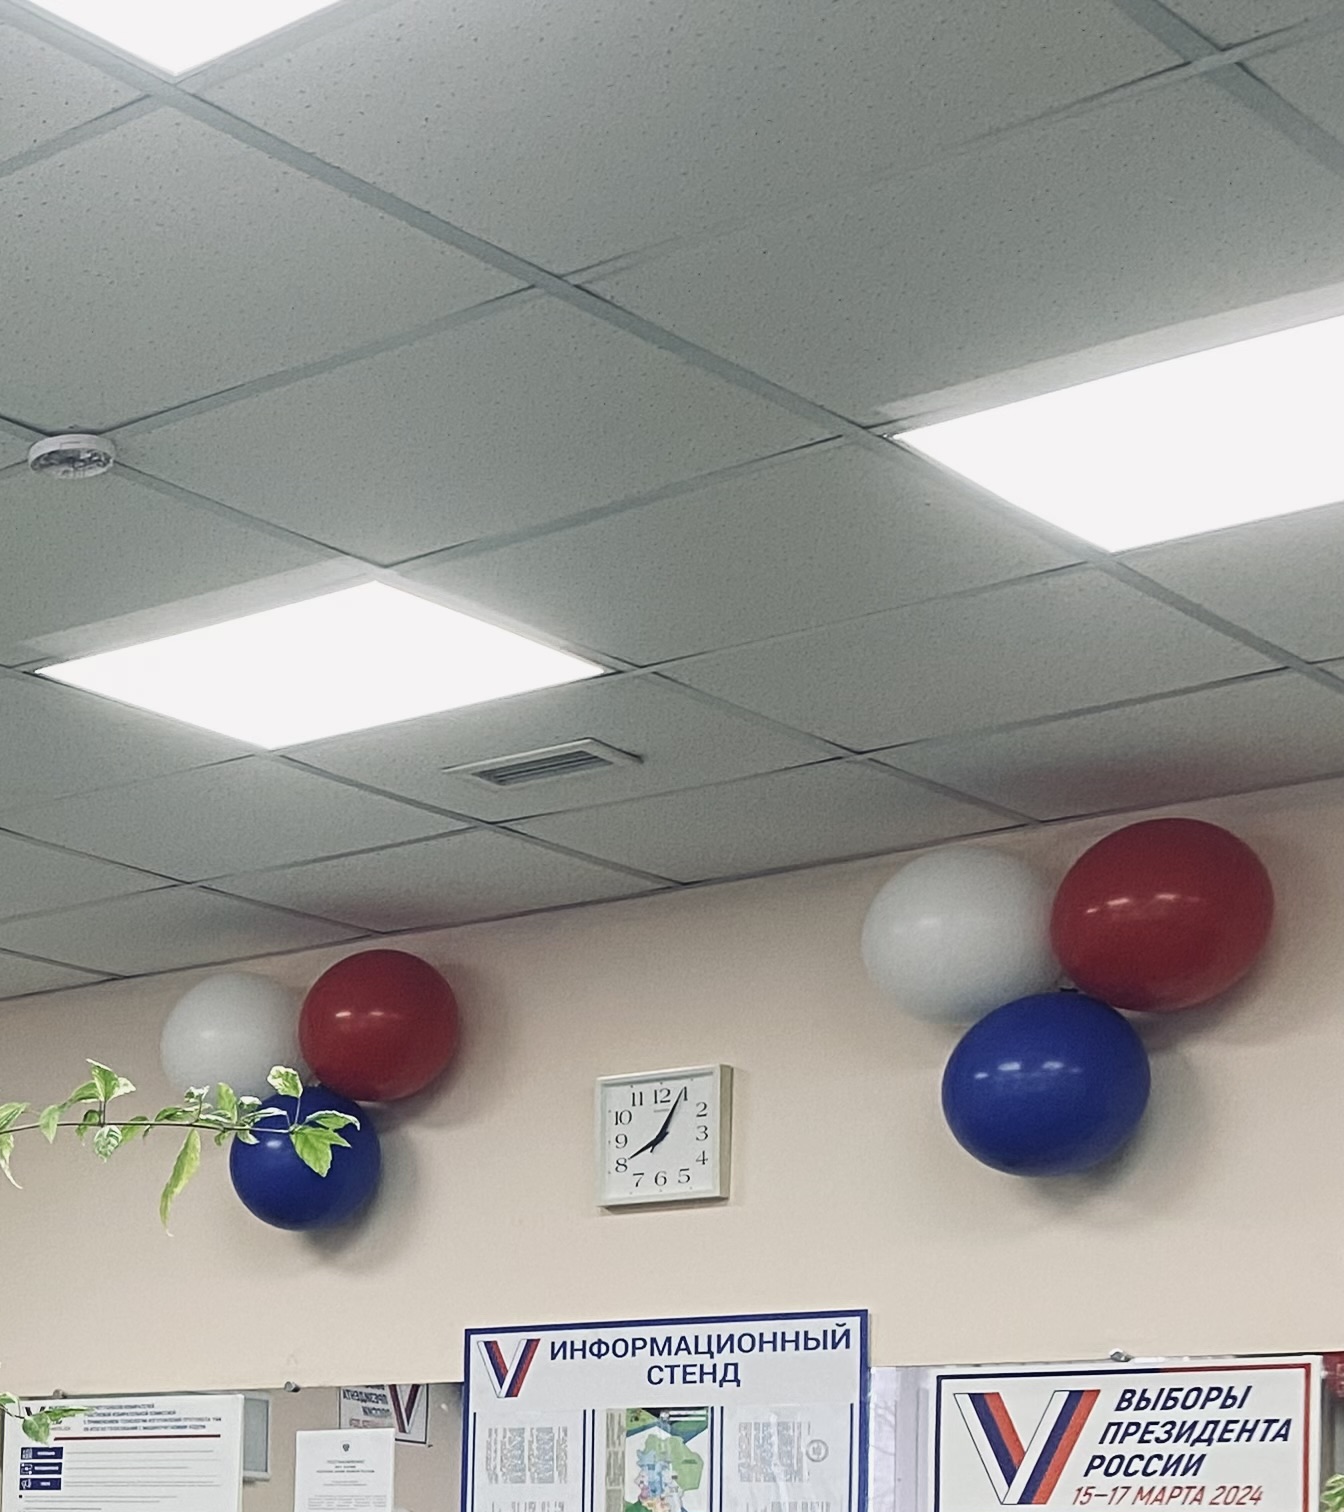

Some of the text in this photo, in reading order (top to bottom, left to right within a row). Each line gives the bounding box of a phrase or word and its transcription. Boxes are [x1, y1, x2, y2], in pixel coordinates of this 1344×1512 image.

[632, 1091, 643, 1106] 11
[654, 1088, 671, 1104] 12
[614, 1110, 632, 1125] 10
[696, 1102, 708, 1117] 2
[696, 1125, 709, 1141] 3
[615, 1134, 628, 1149] 9
[615, 1157, 628, 1173] 8
[695, 1150, 708, 1165] 4
[633, 1173, 644, 1187] 7
[654, 1171, 667, 1186] 6
[678, 1168, 690, 1184] 5
[550, 1322, 851, 1360] ИНФОРМАЦИОННЫЙ
[647, 1363, 741, 1387] СТЕНД
[1114, 1385, 1252, 1412] ВЫБОРЫ
[1098, 1418, 1292, 1446] ПРЕЗИДЕНТА
[1083, 1454, 1207, 1477] РОССИИ
[1072, 1485, 1263, 1505] 15–17 МАРТА 2024
